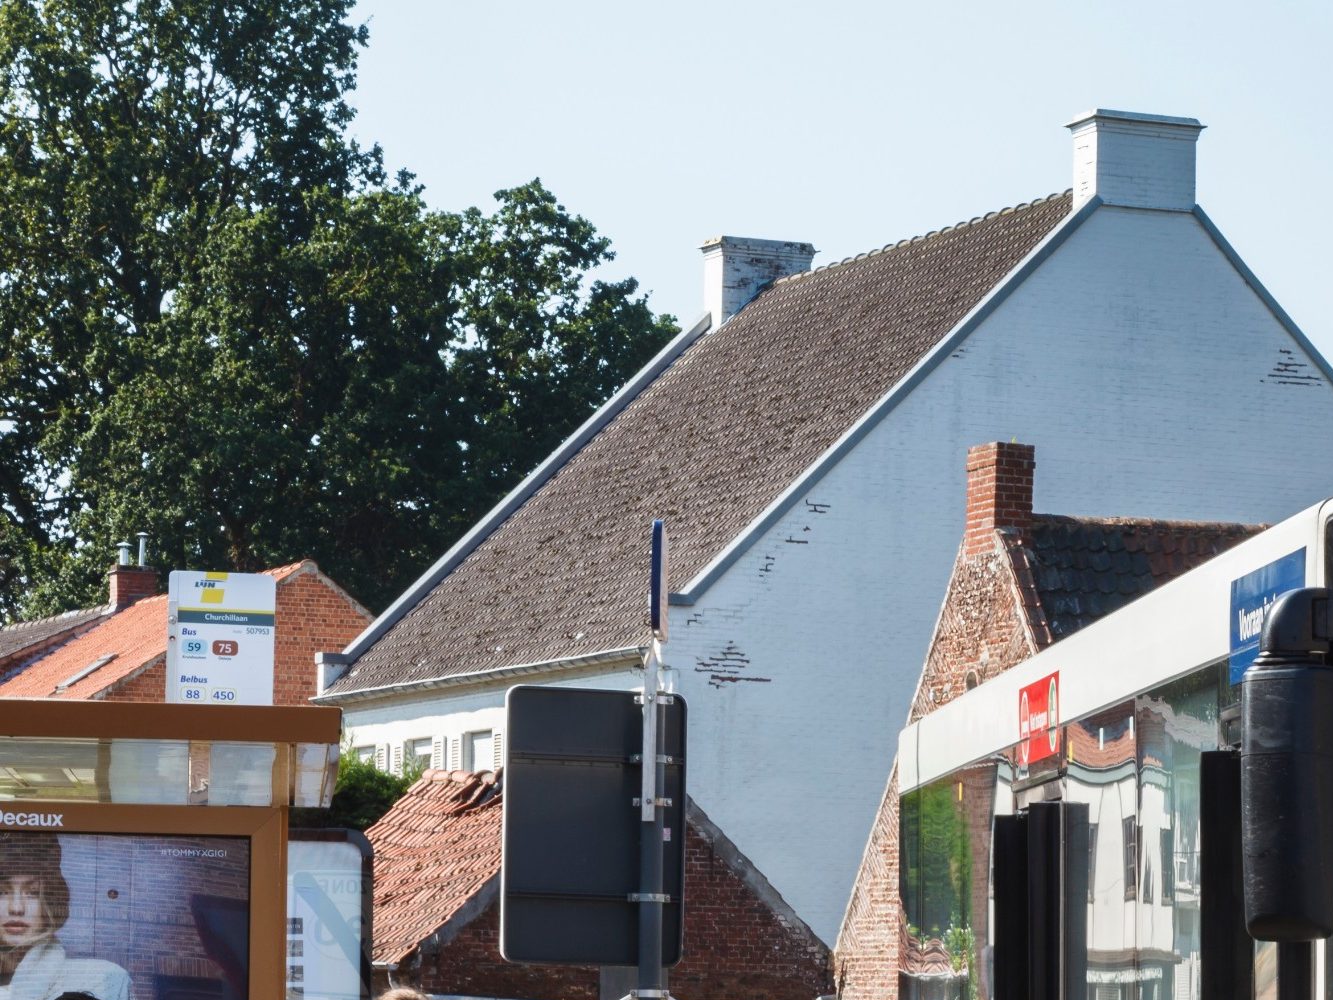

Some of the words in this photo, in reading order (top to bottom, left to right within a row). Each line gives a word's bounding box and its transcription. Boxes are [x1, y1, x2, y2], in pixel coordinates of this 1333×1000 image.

[204, 613, 248, 622] Churchillaan
[181, 628, 197, 636] Bus
[187, 643, 201, 652] 59
[218, 644, 232, 653] 75
[180, 675, 208, 684] Belbus
[186, 689, 200, 699] 88
[213, 691, 234, 700] 450
[0, 810, 63, 826] ecaux
